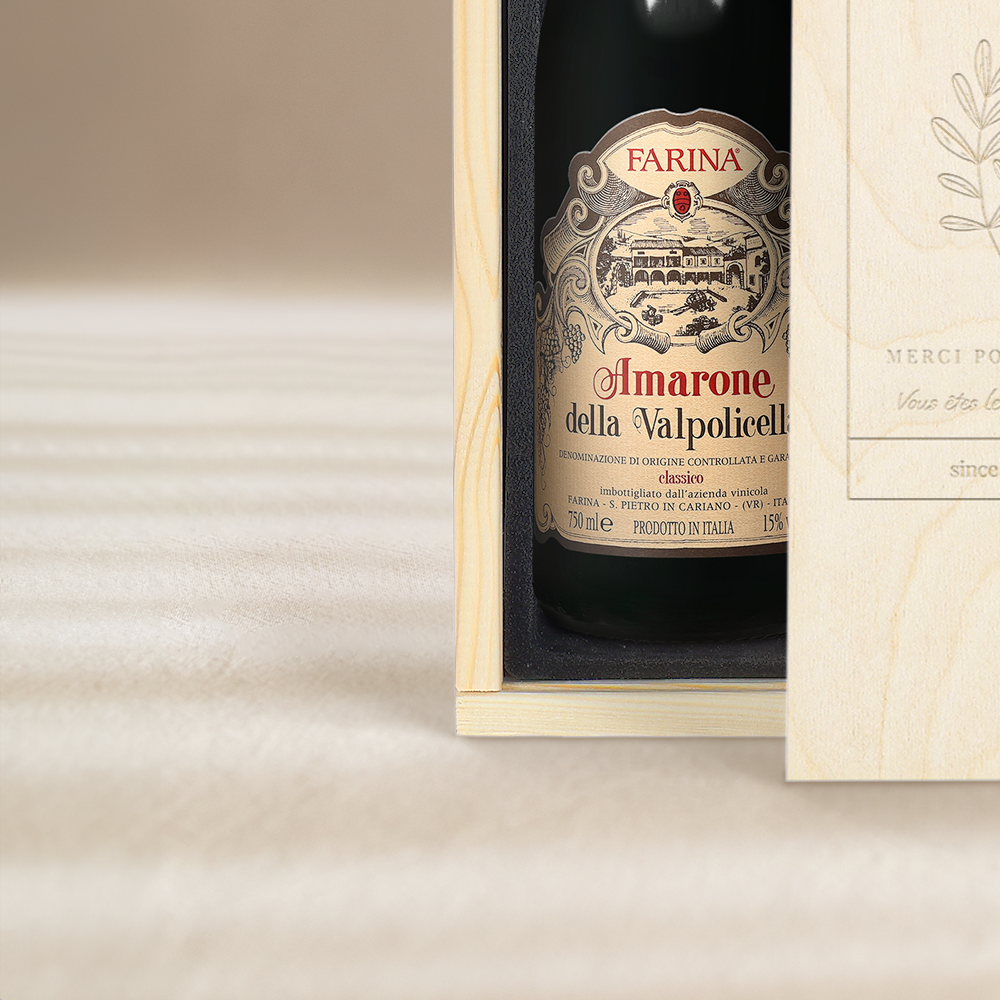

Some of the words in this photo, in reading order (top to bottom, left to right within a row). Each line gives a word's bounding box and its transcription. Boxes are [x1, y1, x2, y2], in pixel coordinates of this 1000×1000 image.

[886, 348, 962, 365] MERCI
[593, 357, 776, 400] Amarone
[897, 388, 939, 411] Vous
[944, 392, 979, 412] êtes
[565, 402, 622, 437] della
[632, 403, 789, 451] Valpolicell
[558, 449, 627, 465] DENOMINAZIONE
[629, 456, 640, 466] DI
[642, 457, 685, 467] ORIGINE
[687, 455, 758, 467] CONTROLLATA
[759, 454, 766, 464] E
[658, 469, 704, 485] classico
[949, 460, 999, 478] since
[600, 486, 662, 500] imbottigliato
[731, 486, 768, 498] vinicola
[567, 494, 600, 508] FARINA
[609, 499, 618, 509] S.
[621, 500, 660, 511] PIETRO
[663, 502, 675, 511] IN
[678, 501, 731, 511] CARIANO
[742, 500, 764, 512] (VR)
[568, 510, 584, 530] 750
[586, 512, 599, 532] ml
[633, 520, 686, 536] PRODOTTO
[688, 521, 700, 536] IN
[702, 520, 735, 535] ITALIA
[763, 512, 784, 533] 15%
